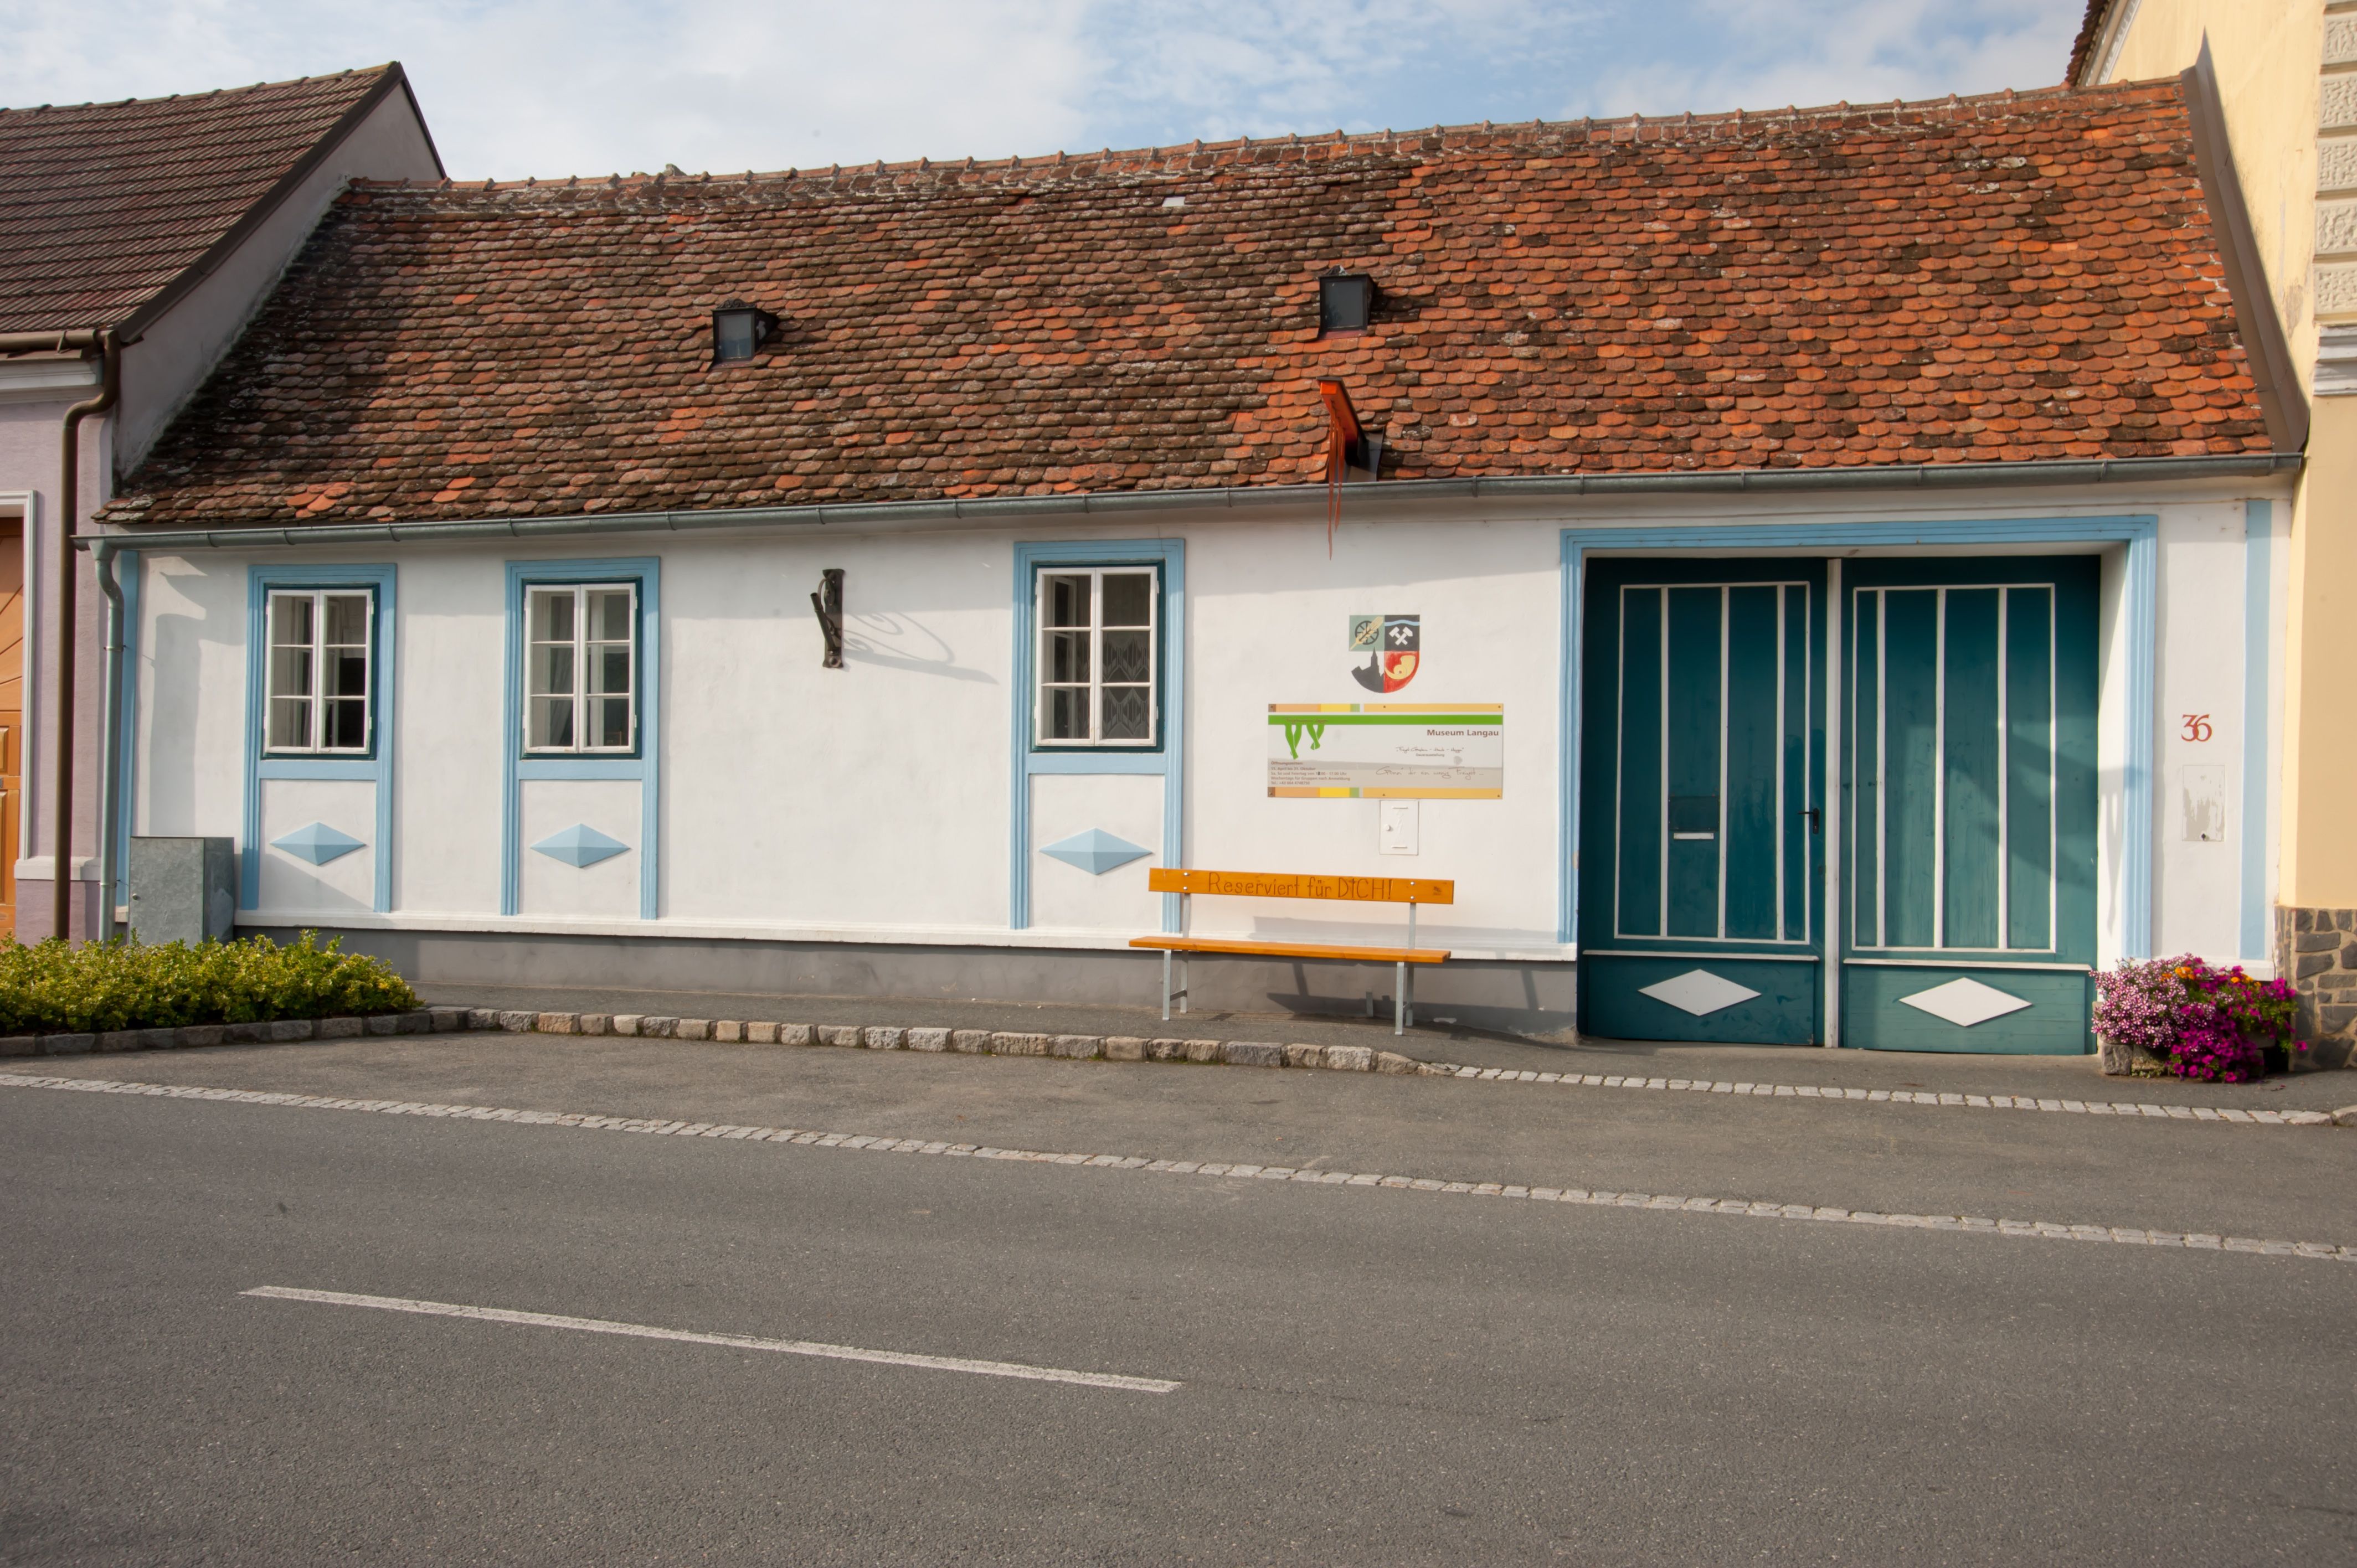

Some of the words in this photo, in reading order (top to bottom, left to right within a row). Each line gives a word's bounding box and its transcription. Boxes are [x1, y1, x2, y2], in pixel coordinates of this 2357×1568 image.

[1467, 729, 1499, 737] Langau
[2181, 714, 2212, 742] 36
[1208, 871, 1300, 896] Reserviert
[1307, 876, 1332, 898] für
